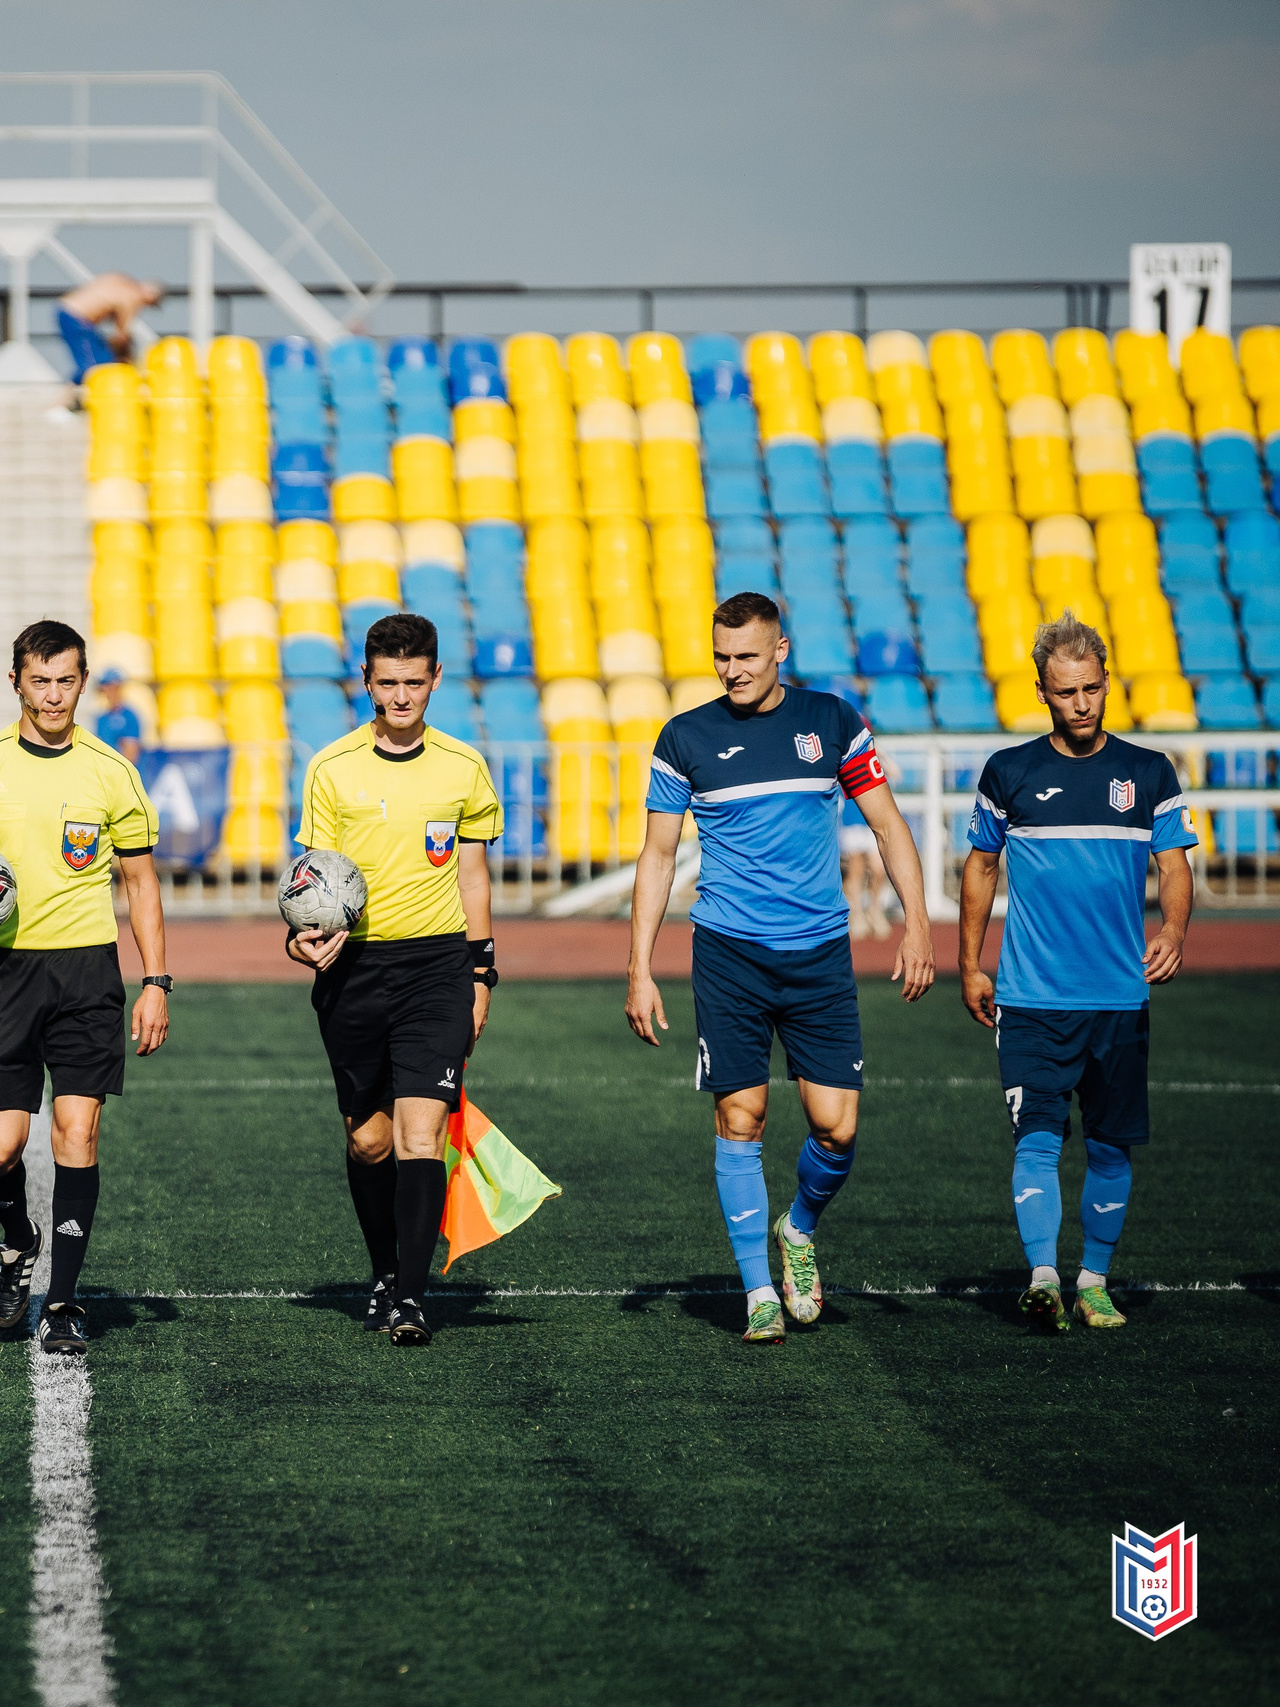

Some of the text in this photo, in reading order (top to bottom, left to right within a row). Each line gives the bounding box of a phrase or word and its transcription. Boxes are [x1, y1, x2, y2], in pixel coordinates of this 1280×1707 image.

[1151, 280, 1210, 333] 17
[869, 755, 885, 778] C
[56, 1226, 84, 1237] adidas
